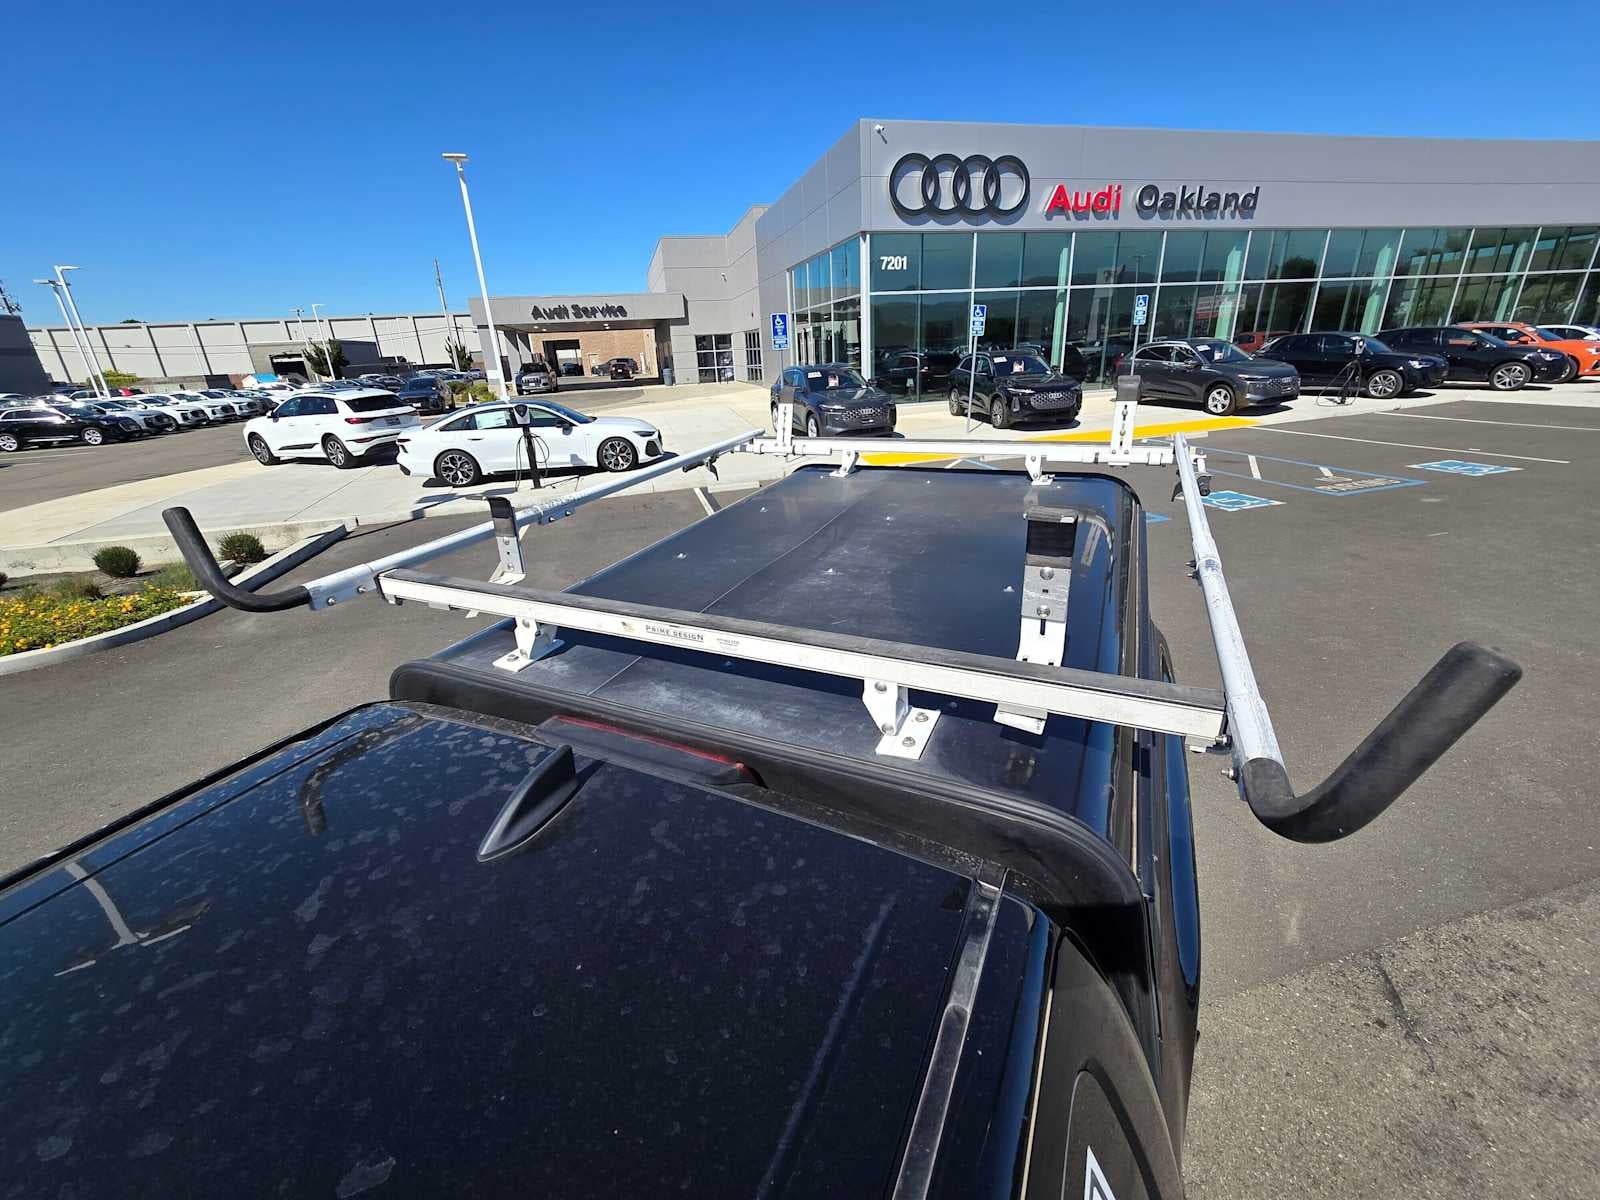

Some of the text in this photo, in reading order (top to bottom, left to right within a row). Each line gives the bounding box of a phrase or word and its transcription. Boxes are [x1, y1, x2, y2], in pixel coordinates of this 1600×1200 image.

[1046, 184, 1260, 214] Audi Oakland
[880, 255, 908, 270] 7201
[531, 303, 627, 320] Audi Service
[645, 623, 704, 642] PRIME DESIGN
